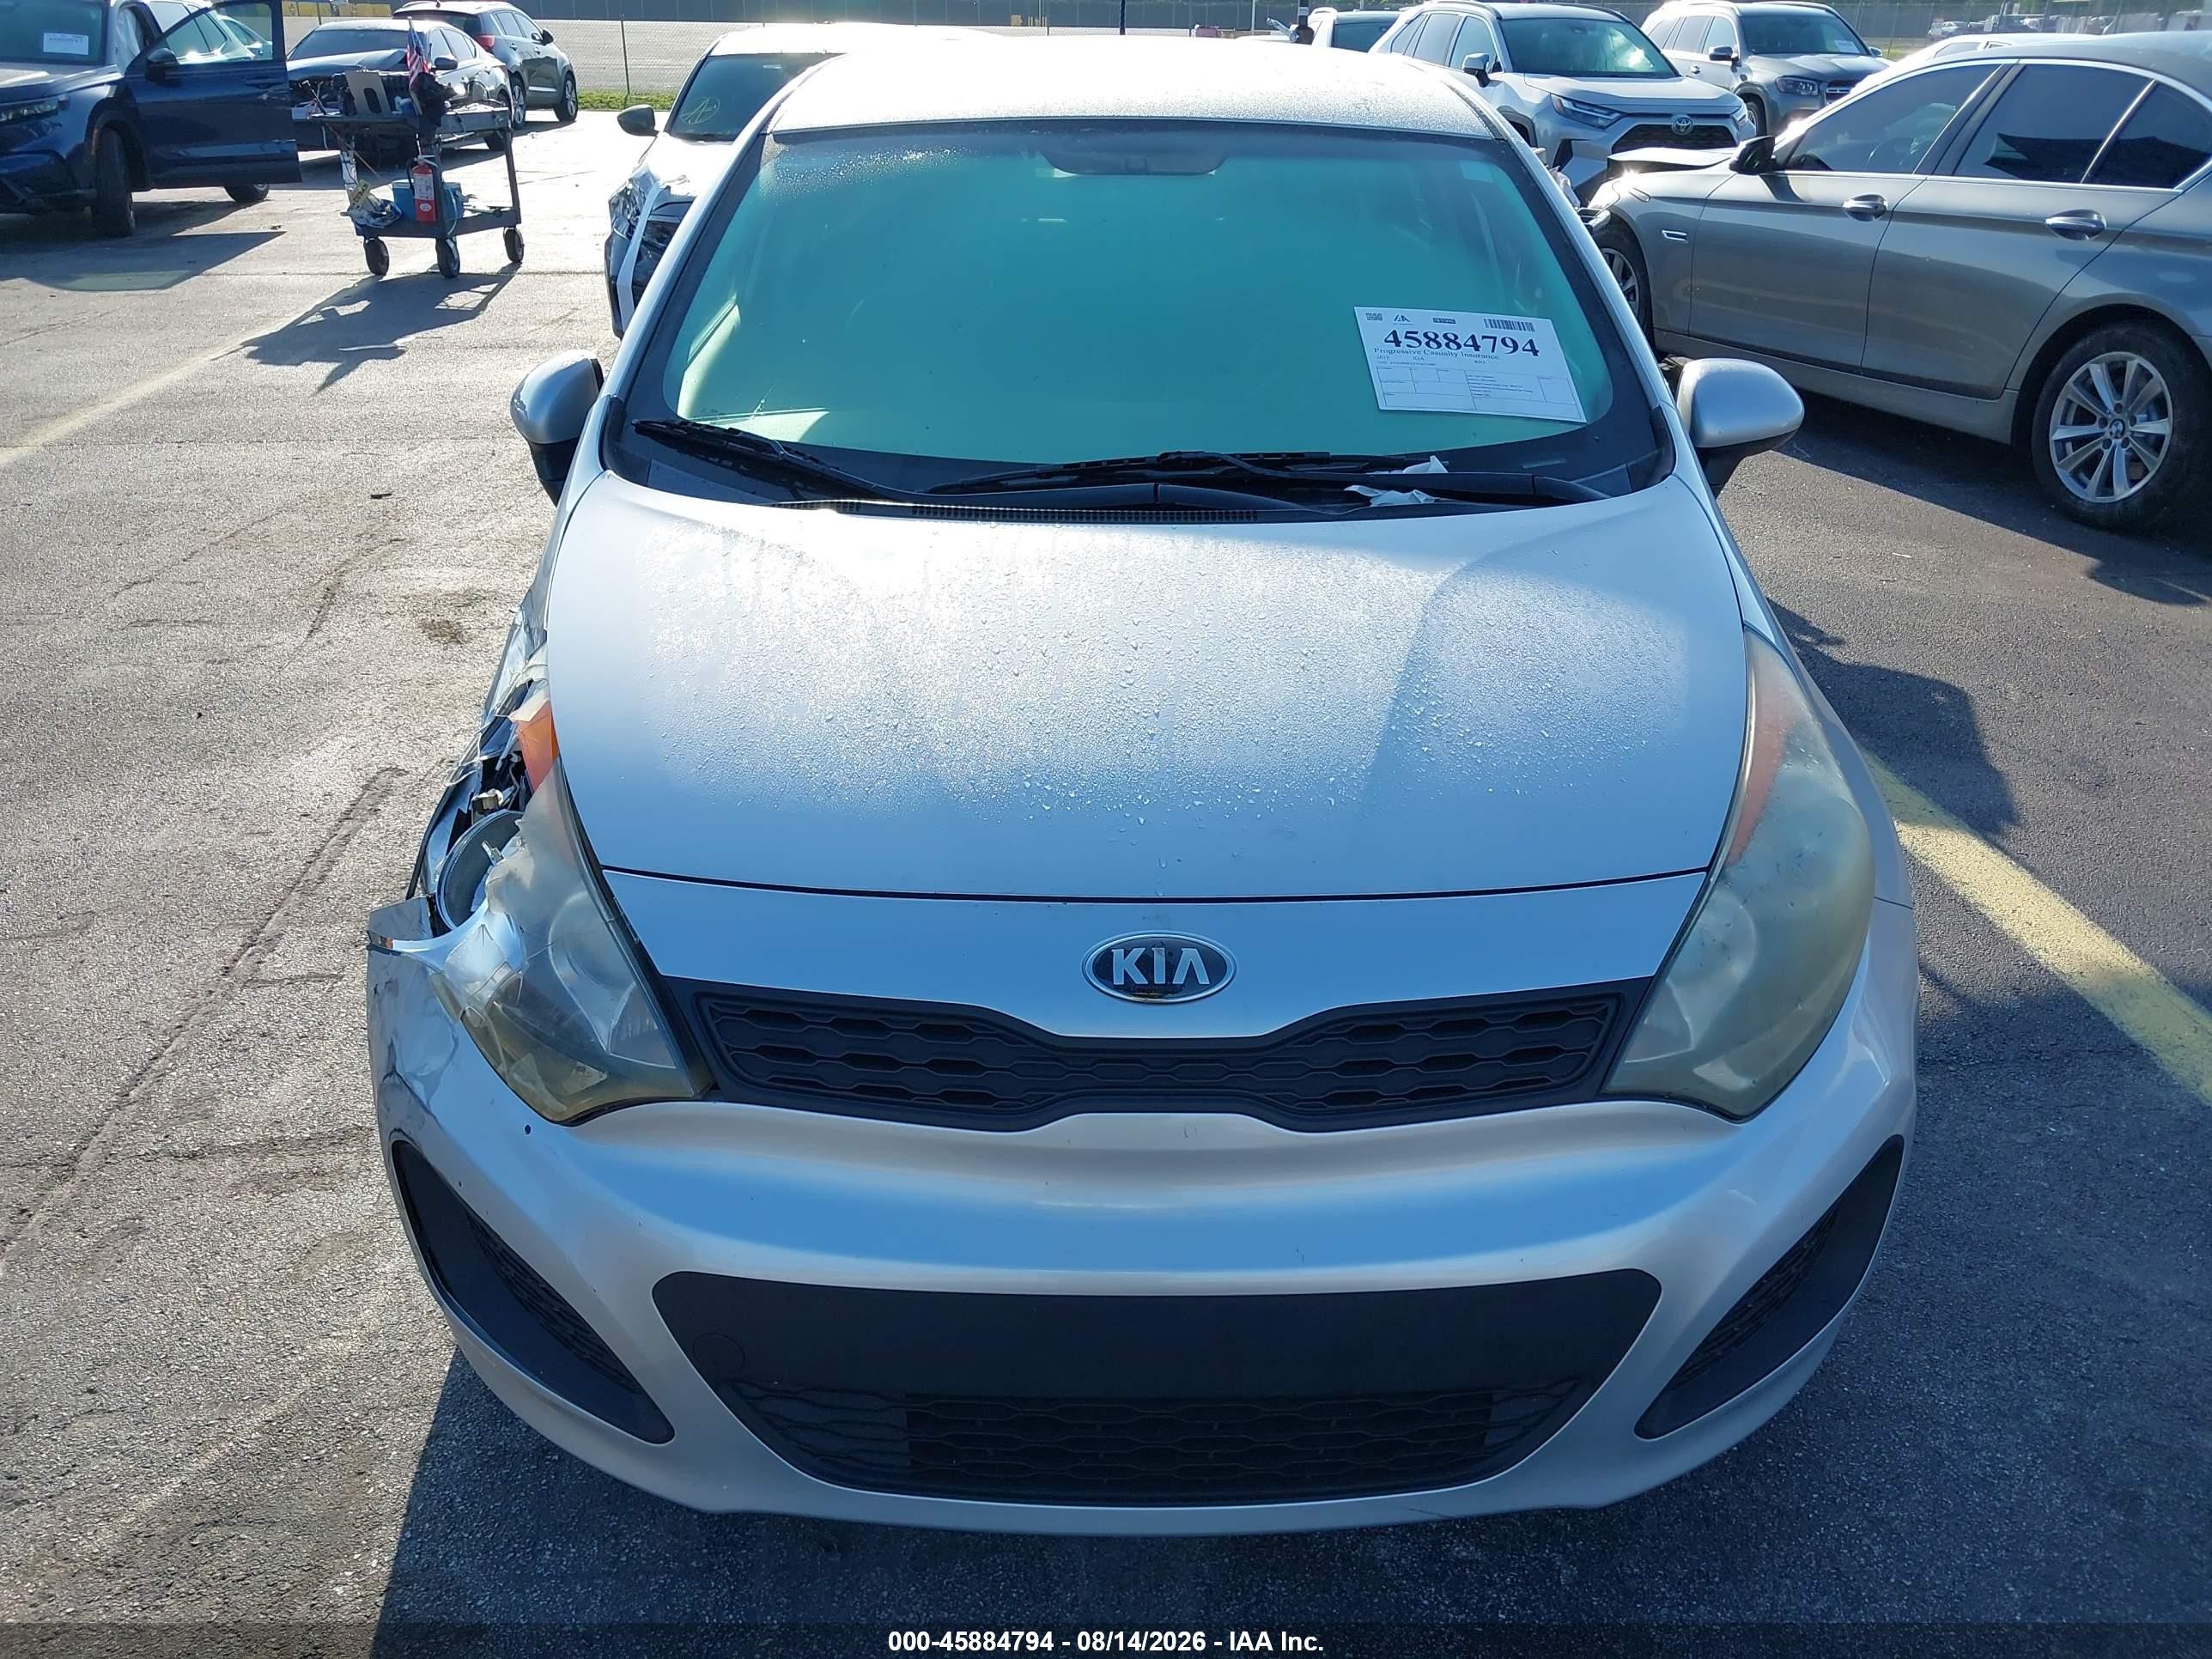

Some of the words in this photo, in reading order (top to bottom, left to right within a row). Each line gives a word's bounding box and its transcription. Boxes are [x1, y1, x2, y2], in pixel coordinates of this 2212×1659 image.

[1374, 347, 1422, 356] Progressive
[1423, 349, 1458, 358] Casualty
[1461, 350, 1500, 360] Insurance
[1383, 329, 1540, 357] 45884794
[1111, 947, 1211, 985] KIA
